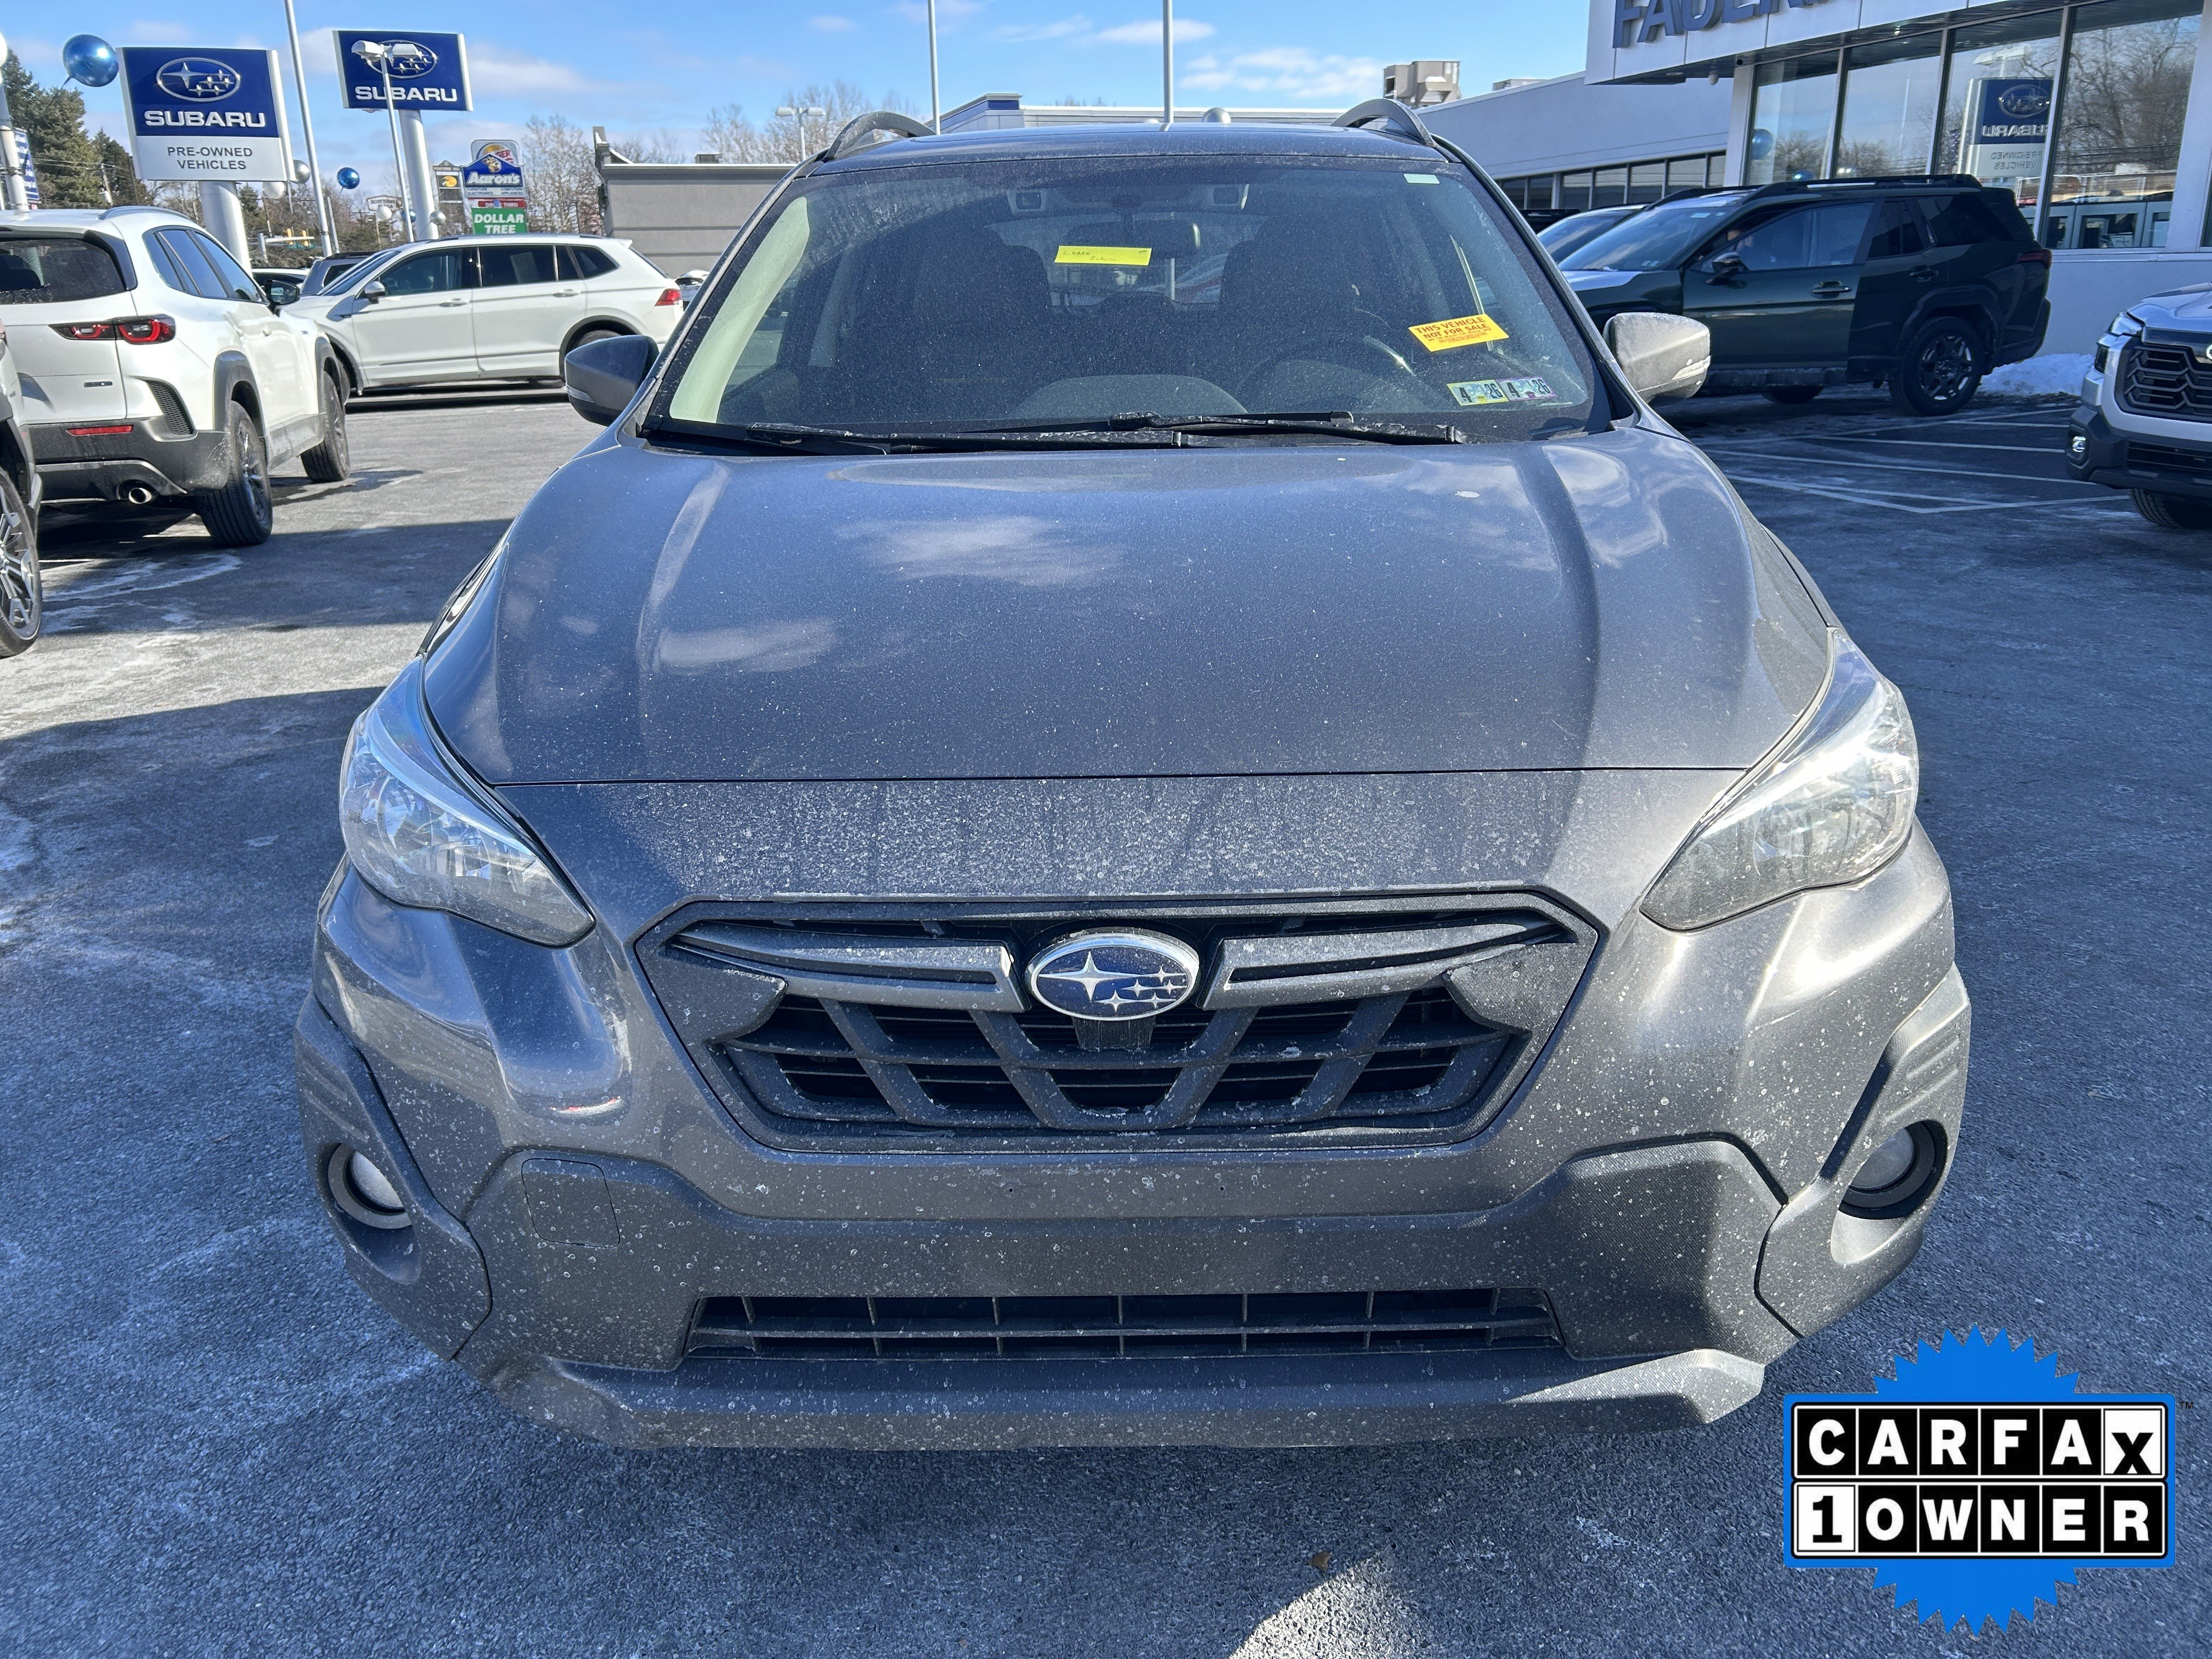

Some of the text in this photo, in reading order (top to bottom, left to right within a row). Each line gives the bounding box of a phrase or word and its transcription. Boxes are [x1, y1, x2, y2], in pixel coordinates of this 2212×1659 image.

[355, 86, 457, 102] SUBARU
[144, 110, 266, 128] SUBARU
[167, 146, 252, 157] PRE-OWNED
[177, 160, 246, 170] VEHICLES
[466, 171, 521, 185] Aaron's
[473, 213, 524, 223] DOLLAR
[484, 224, 516, 234] TREE
[1414, 317, 1486, 334] THIS VEHICLE
[1465, 323, 1489, 331] SALE
[1459, 387, 1473, 403] 4
[1506, 382, 1521, 398] 4
